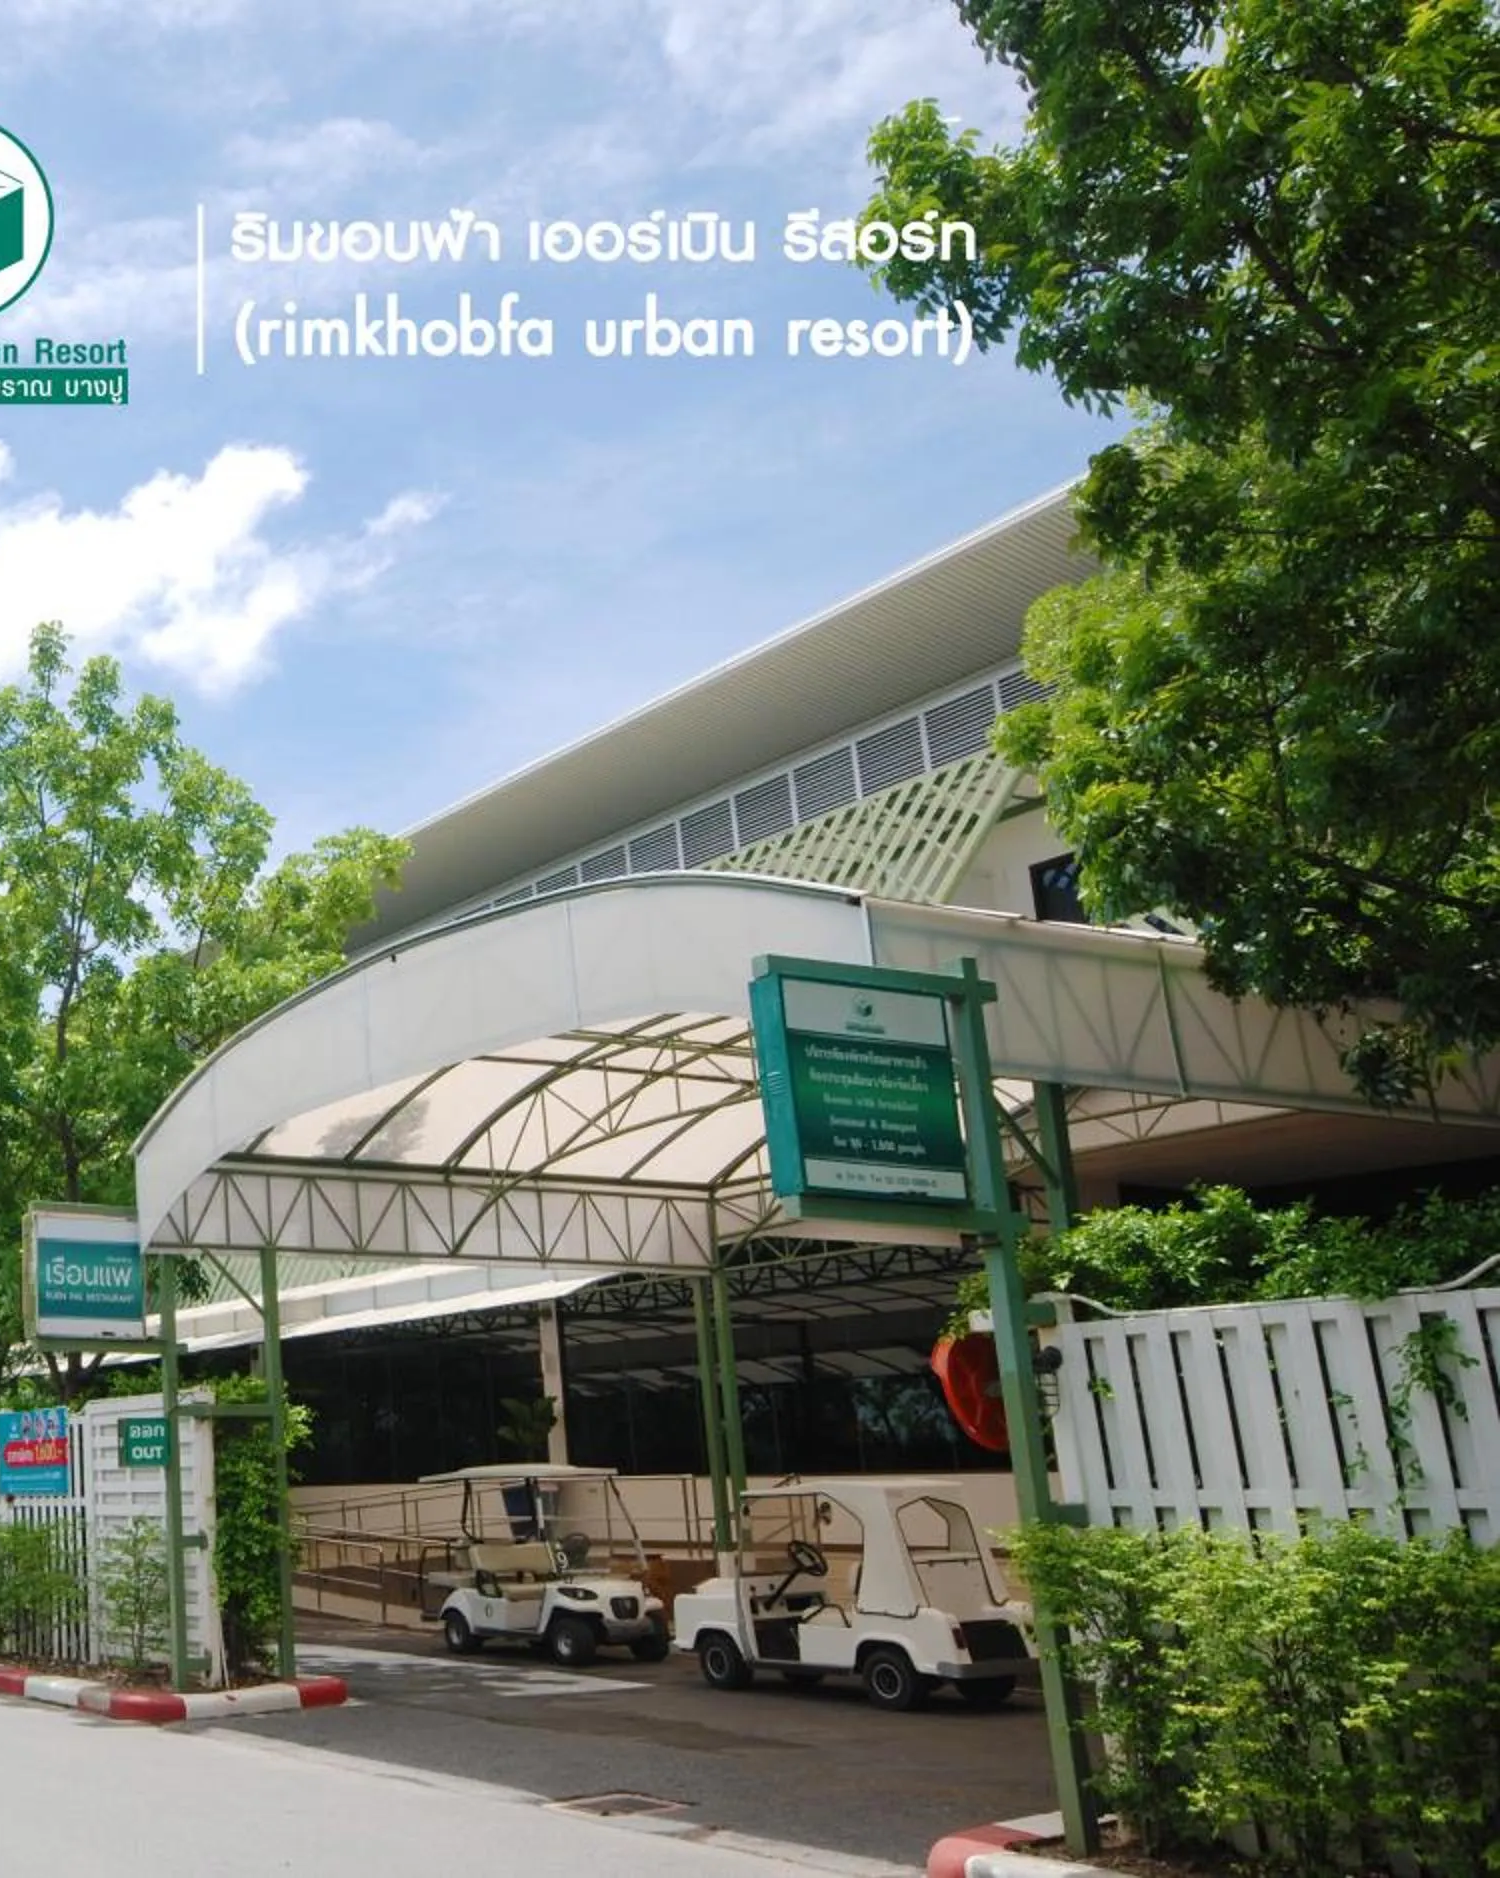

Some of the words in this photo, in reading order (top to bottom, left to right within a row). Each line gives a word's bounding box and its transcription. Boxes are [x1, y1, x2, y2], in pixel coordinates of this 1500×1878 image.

[45, 1255, 133, 1287] เรือนแพ
[129, 1424, 165, 1438] ออก
[132, 1446, 164, 1460] OUT
